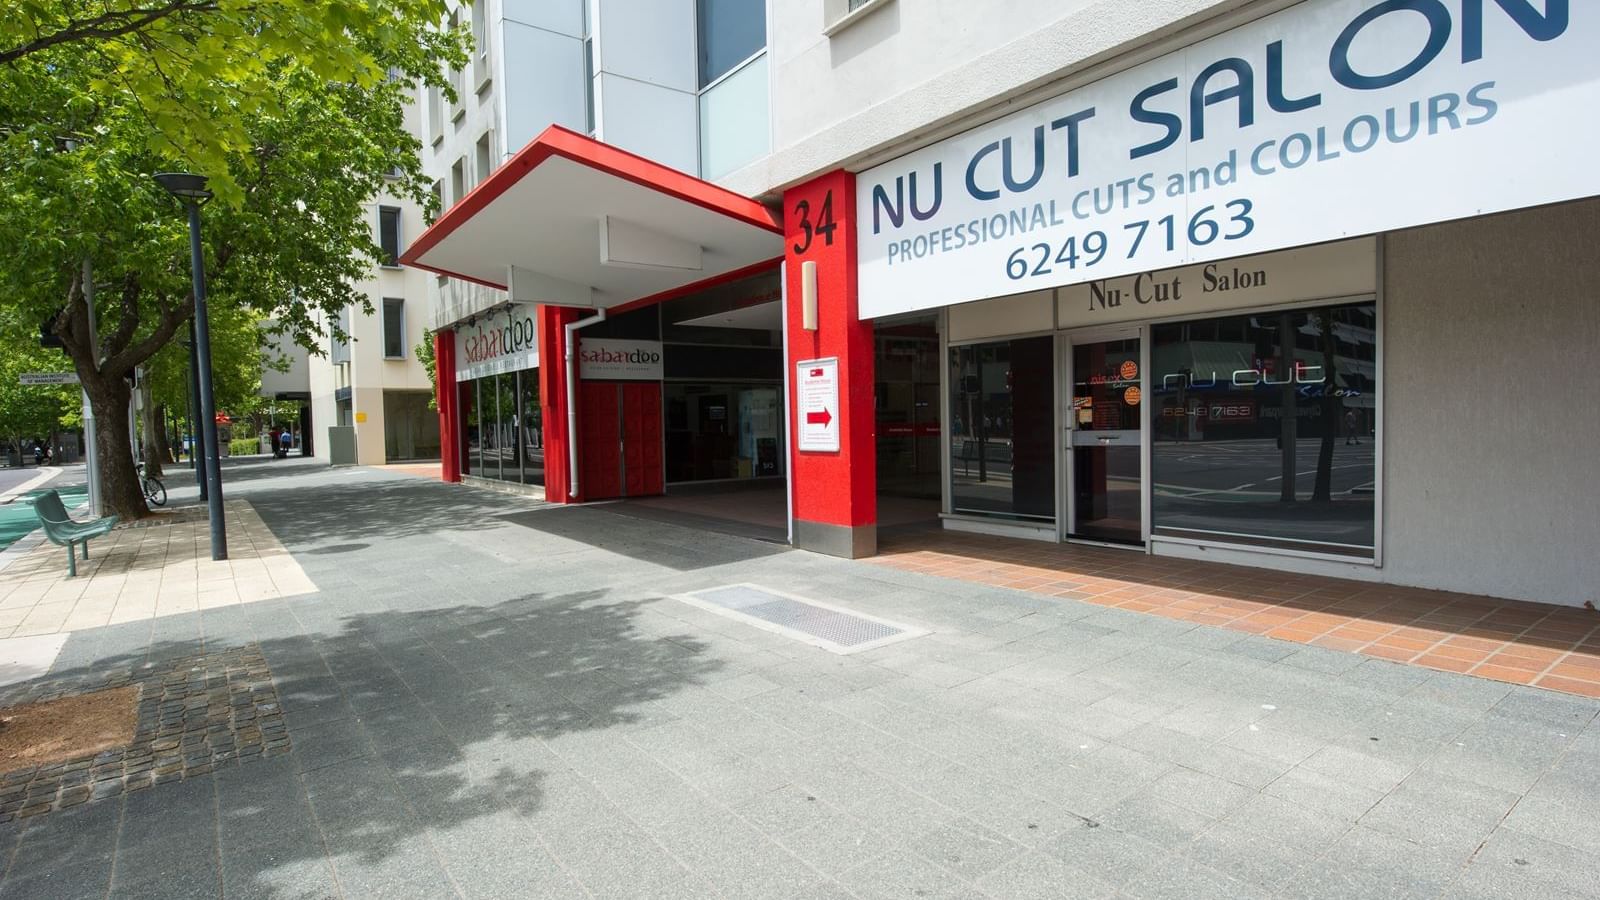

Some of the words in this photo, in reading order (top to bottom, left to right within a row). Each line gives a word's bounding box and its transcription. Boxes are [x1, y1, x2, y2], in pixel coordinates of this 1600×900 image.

[872, 161, 942, 235] NU
[965, 106, 1096, 200] CUT
[1129, 0, 1569, 160] SALON
[888, 200, 1064, 265] PROFESSIONAL
[1071, 173, 1155, 219] CUTS
[1166, 150, 1237, 197] and
[1250, 80, 1499, 176] COLOURS
[793, 189, 837, 255] 34
[1006, 230, 1108, 280] 6249
[1123, 198, 1255, 259] 7163
[1088, 271, 1182, 311] Nu-Cut
[1202, 264, 1266, 293] Salon
[1232, 361, 1326, 386] cut
